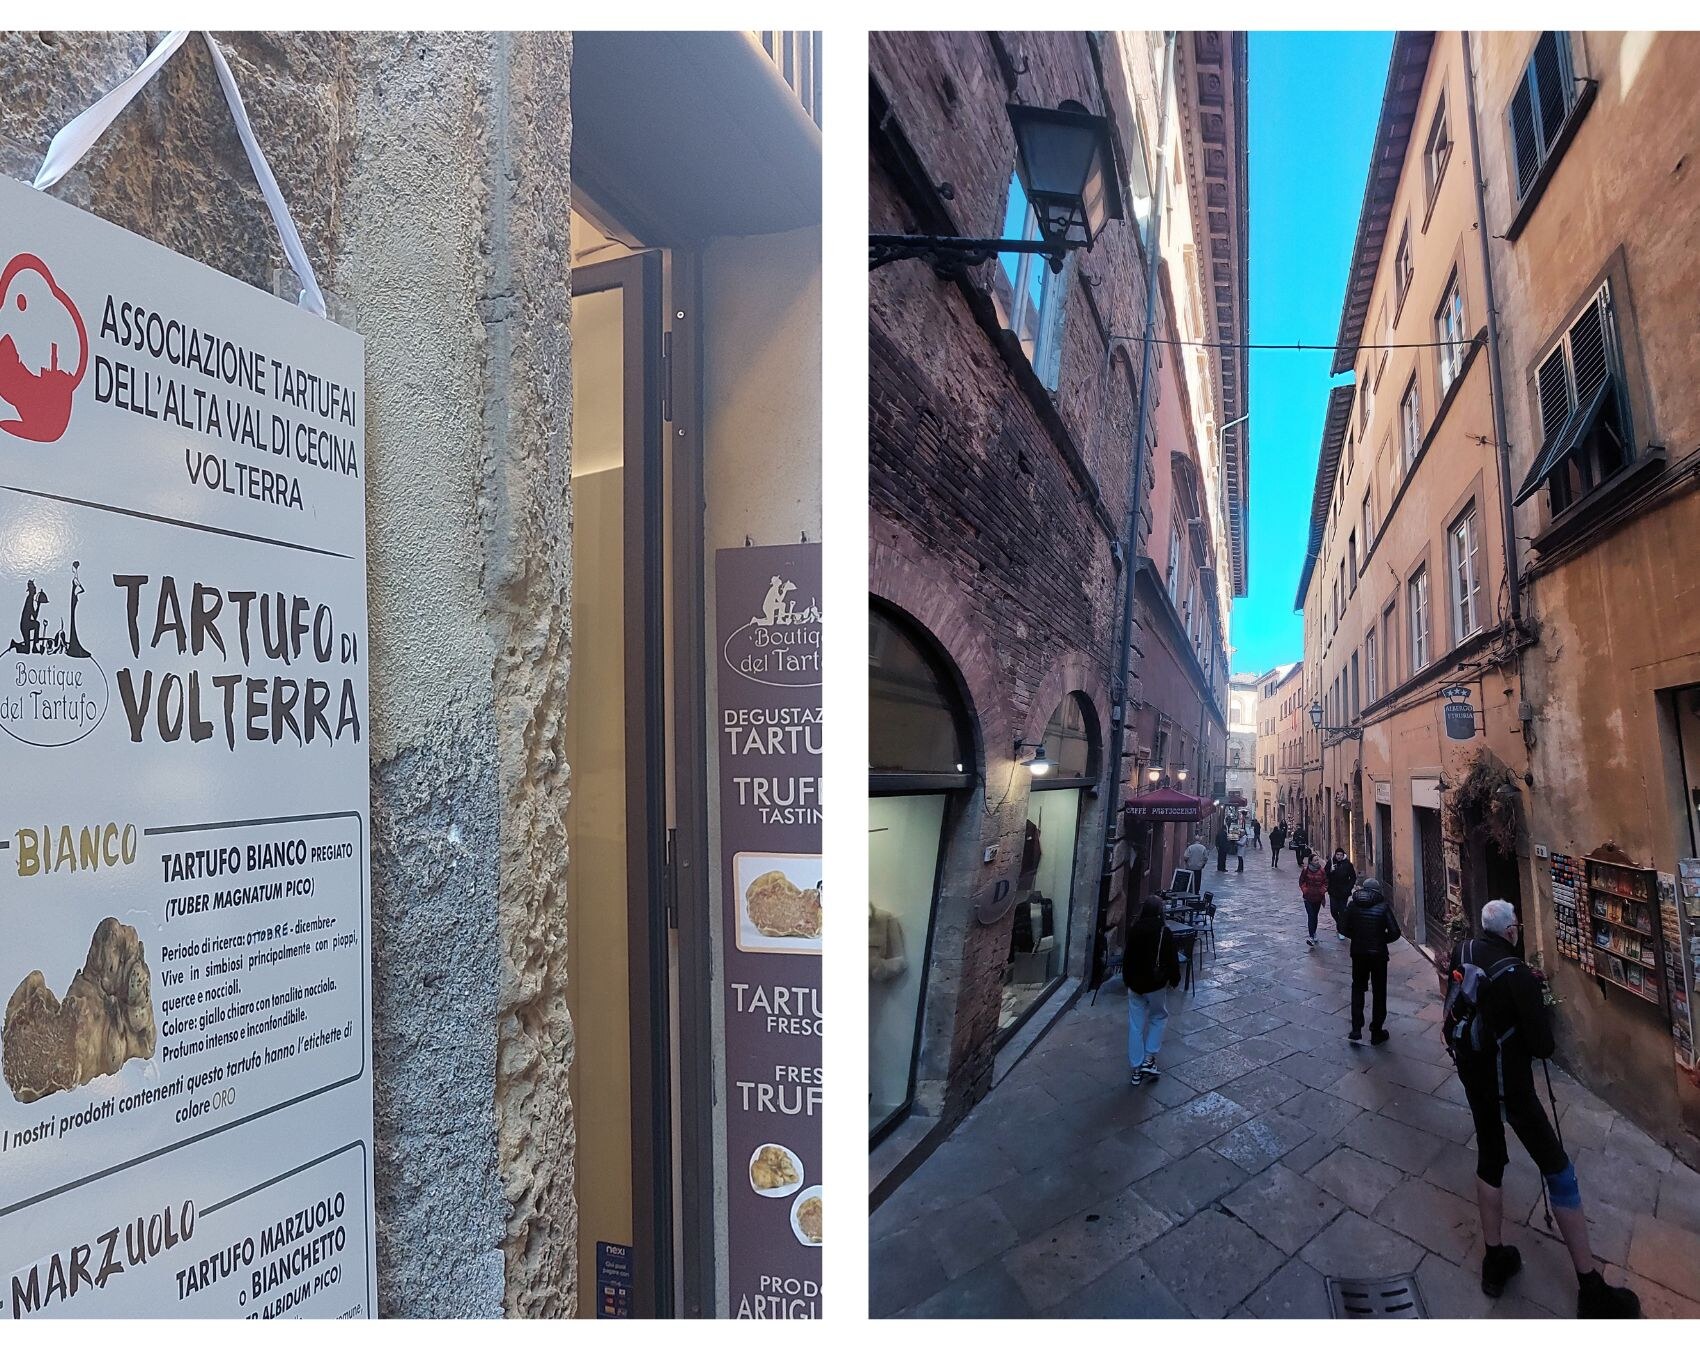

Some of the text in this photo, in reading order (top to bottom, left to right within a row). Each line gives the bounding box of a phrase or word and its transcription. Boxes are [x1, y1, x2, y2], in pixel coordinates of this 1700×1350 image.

[100, 294, 356, 427] ASSOCIAZIONE TARTUFAI
[95, 355, 359, 478] DELL'ALTA VAL DI CECINA
[185, 448, 304, 510] VOLTERRA
[113, 574, 357, 667] TARTUFO DI
[754, 627, 820, 648] Boutiq
[15, 661, 83, 691] Boutique
[740, 647, 820, 674] del Tart
[0, 690, 97, 727] del Tartufo
[116, 667, 361, 752] VOLTERRA
[724, 707, 823, 726] DEGUSTAZ
[724, 725, 823, 755] TARTU
[758, 807, 823, 824] TASTIN
[15, 822, 137, 877] BIANCO
[161, 839, 353, 883] TARTUFO BIANCO PREGIATO
[165, 877, 315, 922] (TUBER MAGNATUM PICO)
[161, 943, 200, 962] Periodo
[201, 937, 211, 954] di
[212, 935, 245, 952] ricerca:
[161, 929, 358, 987] Vive in simbiosi principalmente con pioppi,
[161, 978, 242, 1017] querce e noccioli.
[162, 976, 337, 1037] Colore: giallo chiaro con tonalità nocciola.
[731, 983, 823, 1018] TARTU
[162, 1006, 308, 1063] Profumo intenso e inconfondibile.
[13, 1115, 55, 1148] nostri
[59, 1097, 115, 1138] prodotti
[118, 1075, 183, 1114] contenenti
[186, 1065, 224, 1095] questo
[226, 1051, 262, 1079] tartufo
[264, 1046, 295, 1066] hanno
[297, 1027, 343, 1055] l'etichette
[343, 1020, 353, 1039] di
[775, 1065, 823, 1085] FRES
[175, 1086, 236, 1124] colore ORO
[736, 1081, 823, 1116] TRUF
[11, 1199, 195, 1319] MARZUOLO
[175, 1191, 345, 1301] TARTUFO MARZUOLO
[251, 1225, 346, 1299] BIANCHETTO
[606, 1245, 626, 1256] nexi
[262, 1263, 342, 1319] ALBIDUM PICO)
[736, 1293, 816, 1320] ARTIGI
[760, 1275, 823, 1297] PROD
